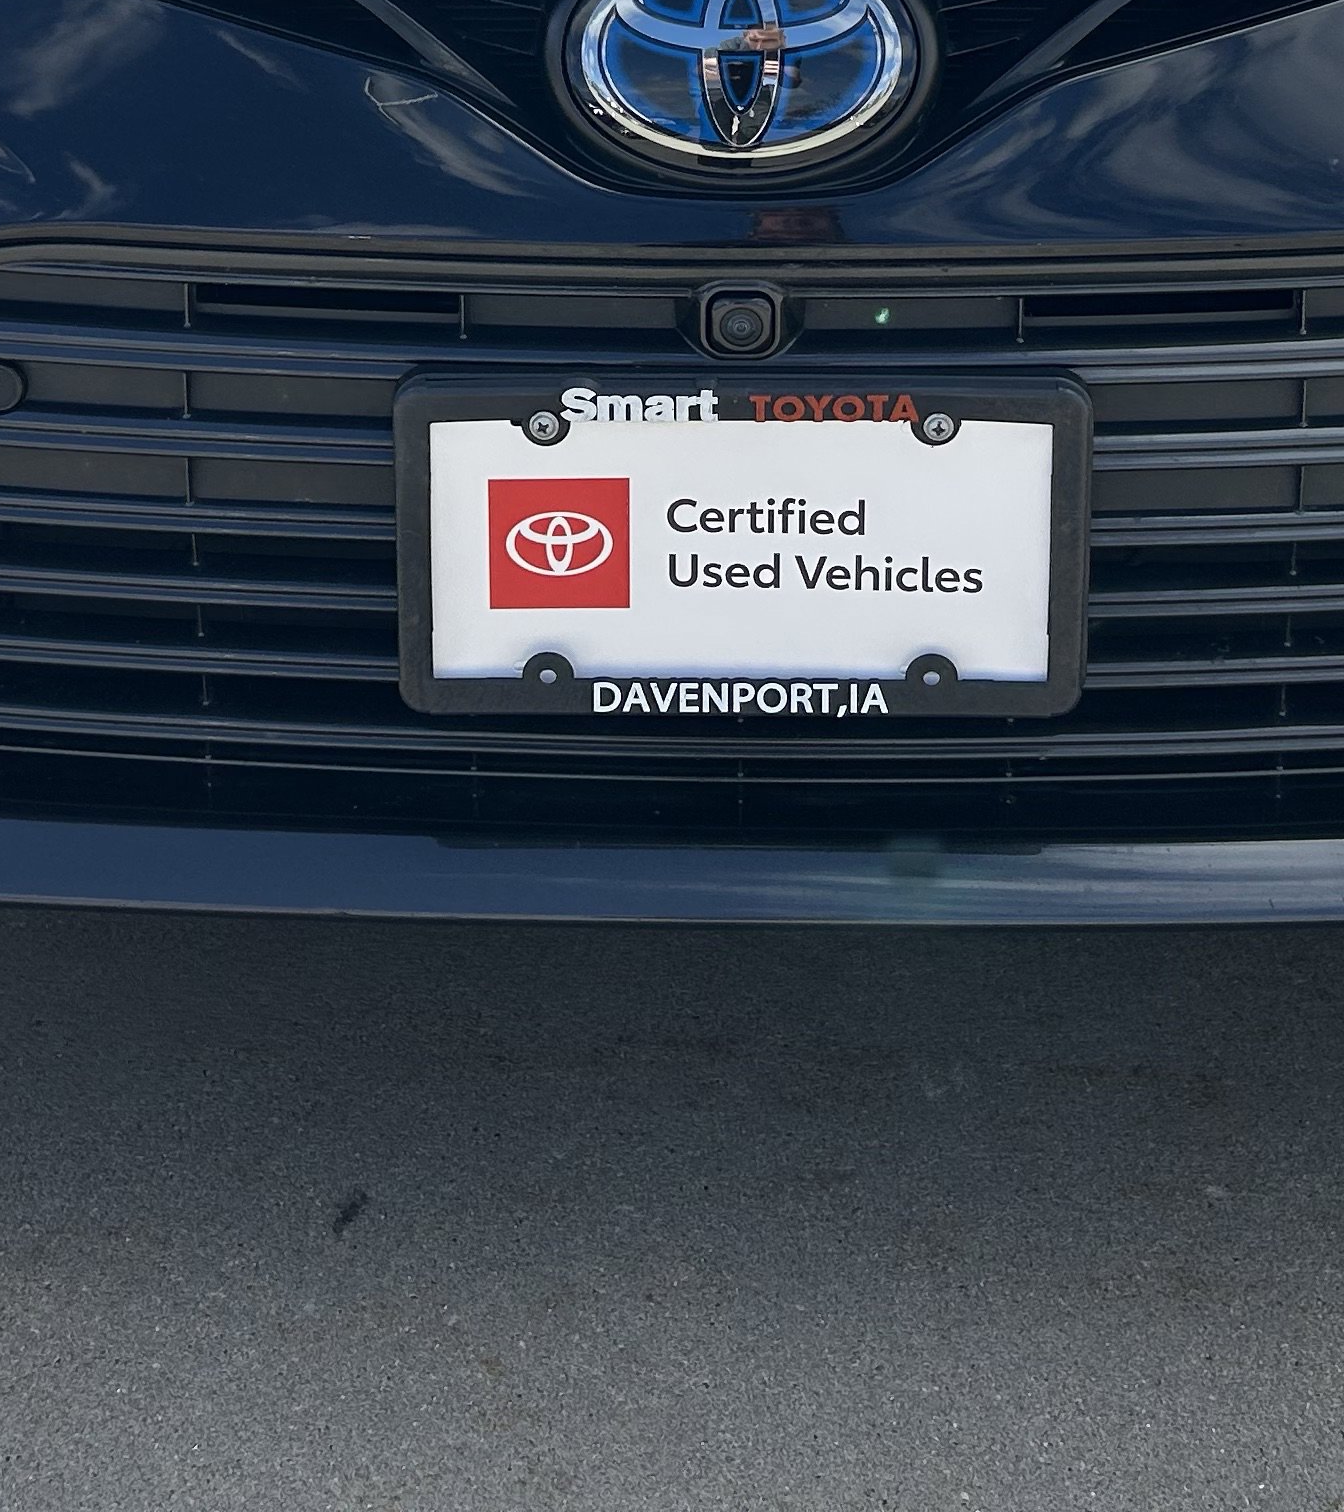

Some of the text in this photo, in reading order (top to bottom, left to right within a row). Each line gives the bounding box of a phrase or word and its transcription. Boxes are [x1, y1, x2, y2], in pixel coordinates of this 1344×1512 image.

[560, 387, 920, 423] Smart TOYOTA
[666, 498, 866, 537] Certified
[668, 553, 983, 594] Used Vehicles
